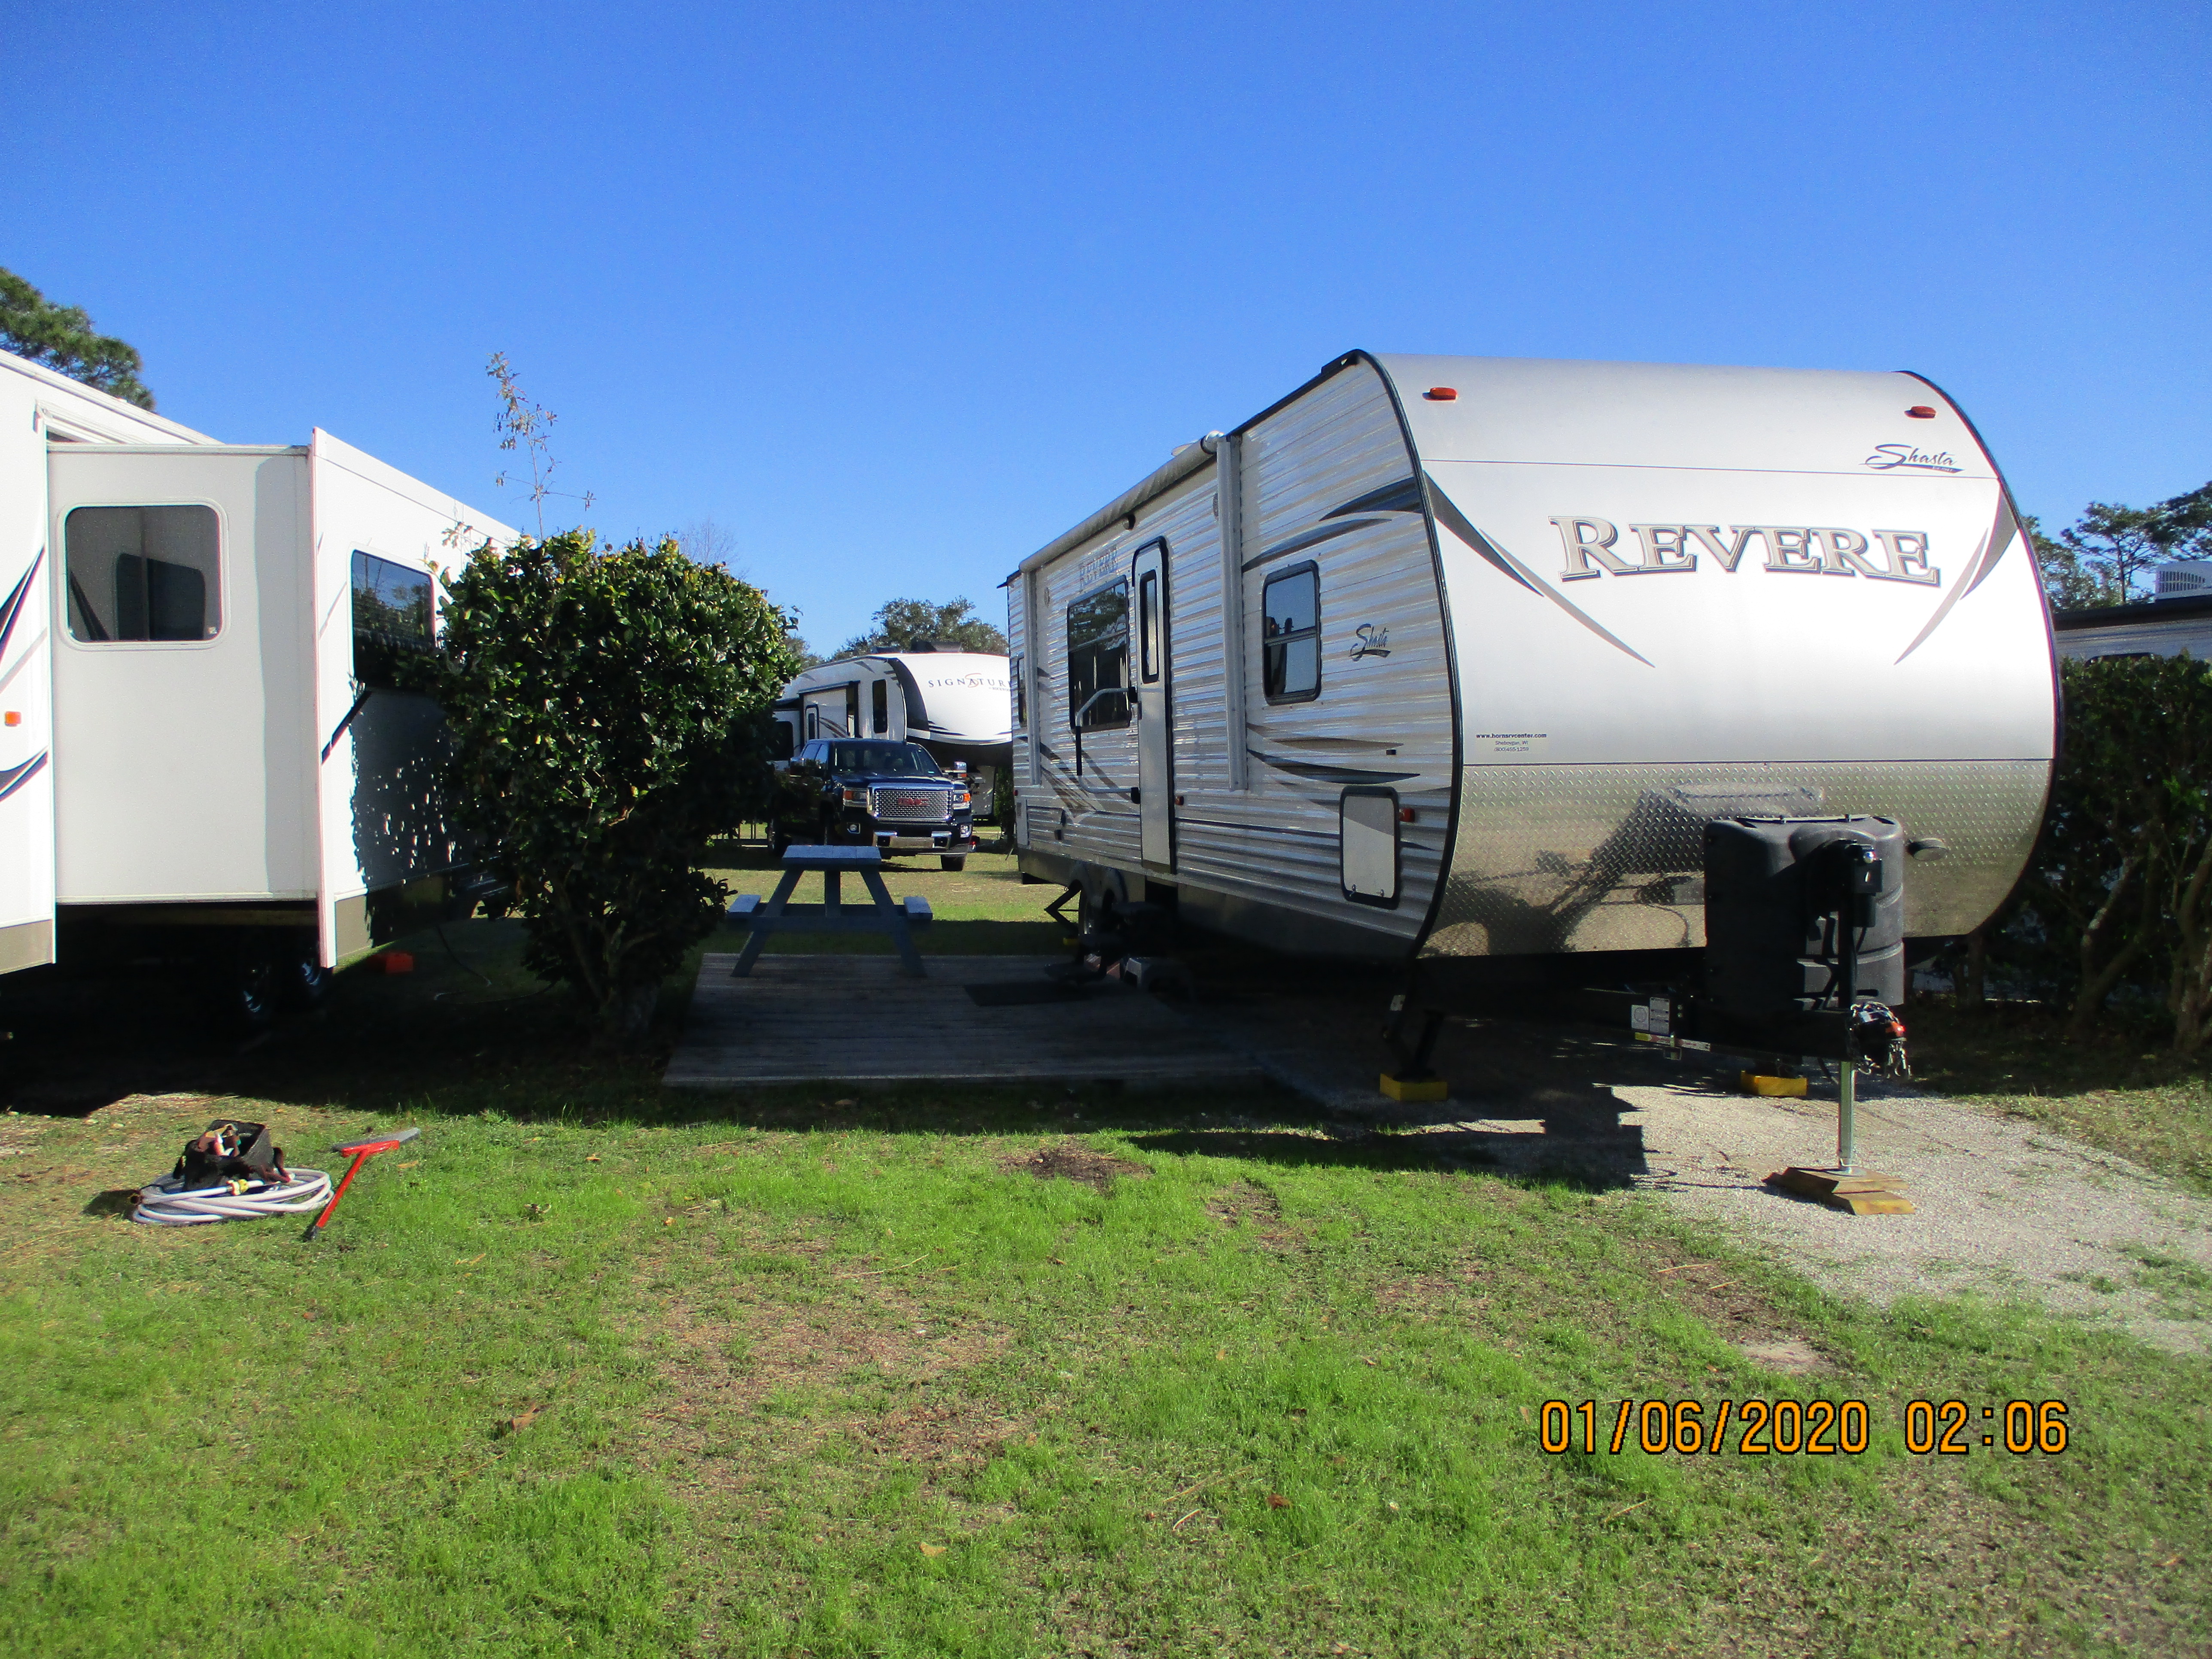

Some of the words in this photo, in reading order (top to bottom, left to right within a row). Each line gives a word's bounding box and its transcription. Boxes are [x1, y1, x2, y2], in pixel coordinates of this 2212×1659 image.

[1862, 444, 1959, 471] Shasta
[1547, 515, 1942, 587] REVERE
[898, 797, 929, 806] GMC
